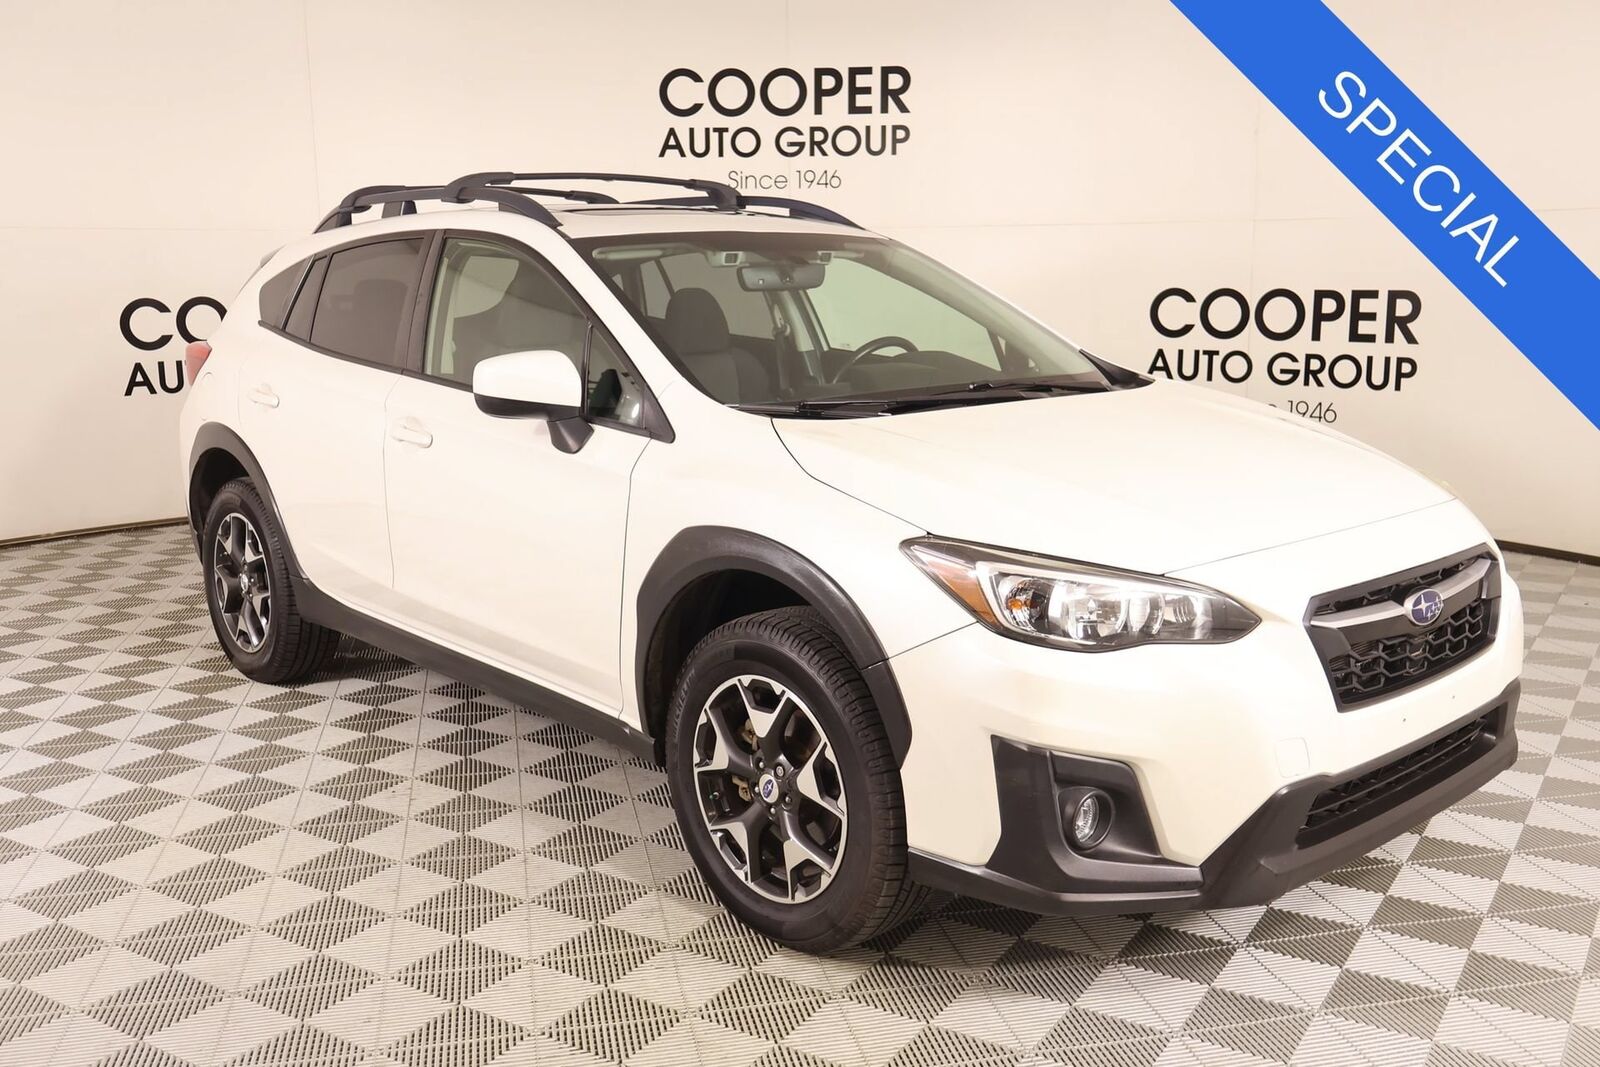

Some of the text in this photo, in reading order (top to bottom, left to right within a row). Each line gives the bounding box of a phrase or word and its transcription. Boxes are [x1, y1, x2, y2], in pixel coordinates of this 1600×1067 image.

[658, 65, 912, 118] COOPER
[658, 124, 911, 159] AUTO GROUP
[728, 169, 842, 190] Since 1946
[1149, 287, 1422, 345] COOPER
[1148, 348, 1418, 392] AUTO GROUP
[1287, 400, 1338, 424] 1946
